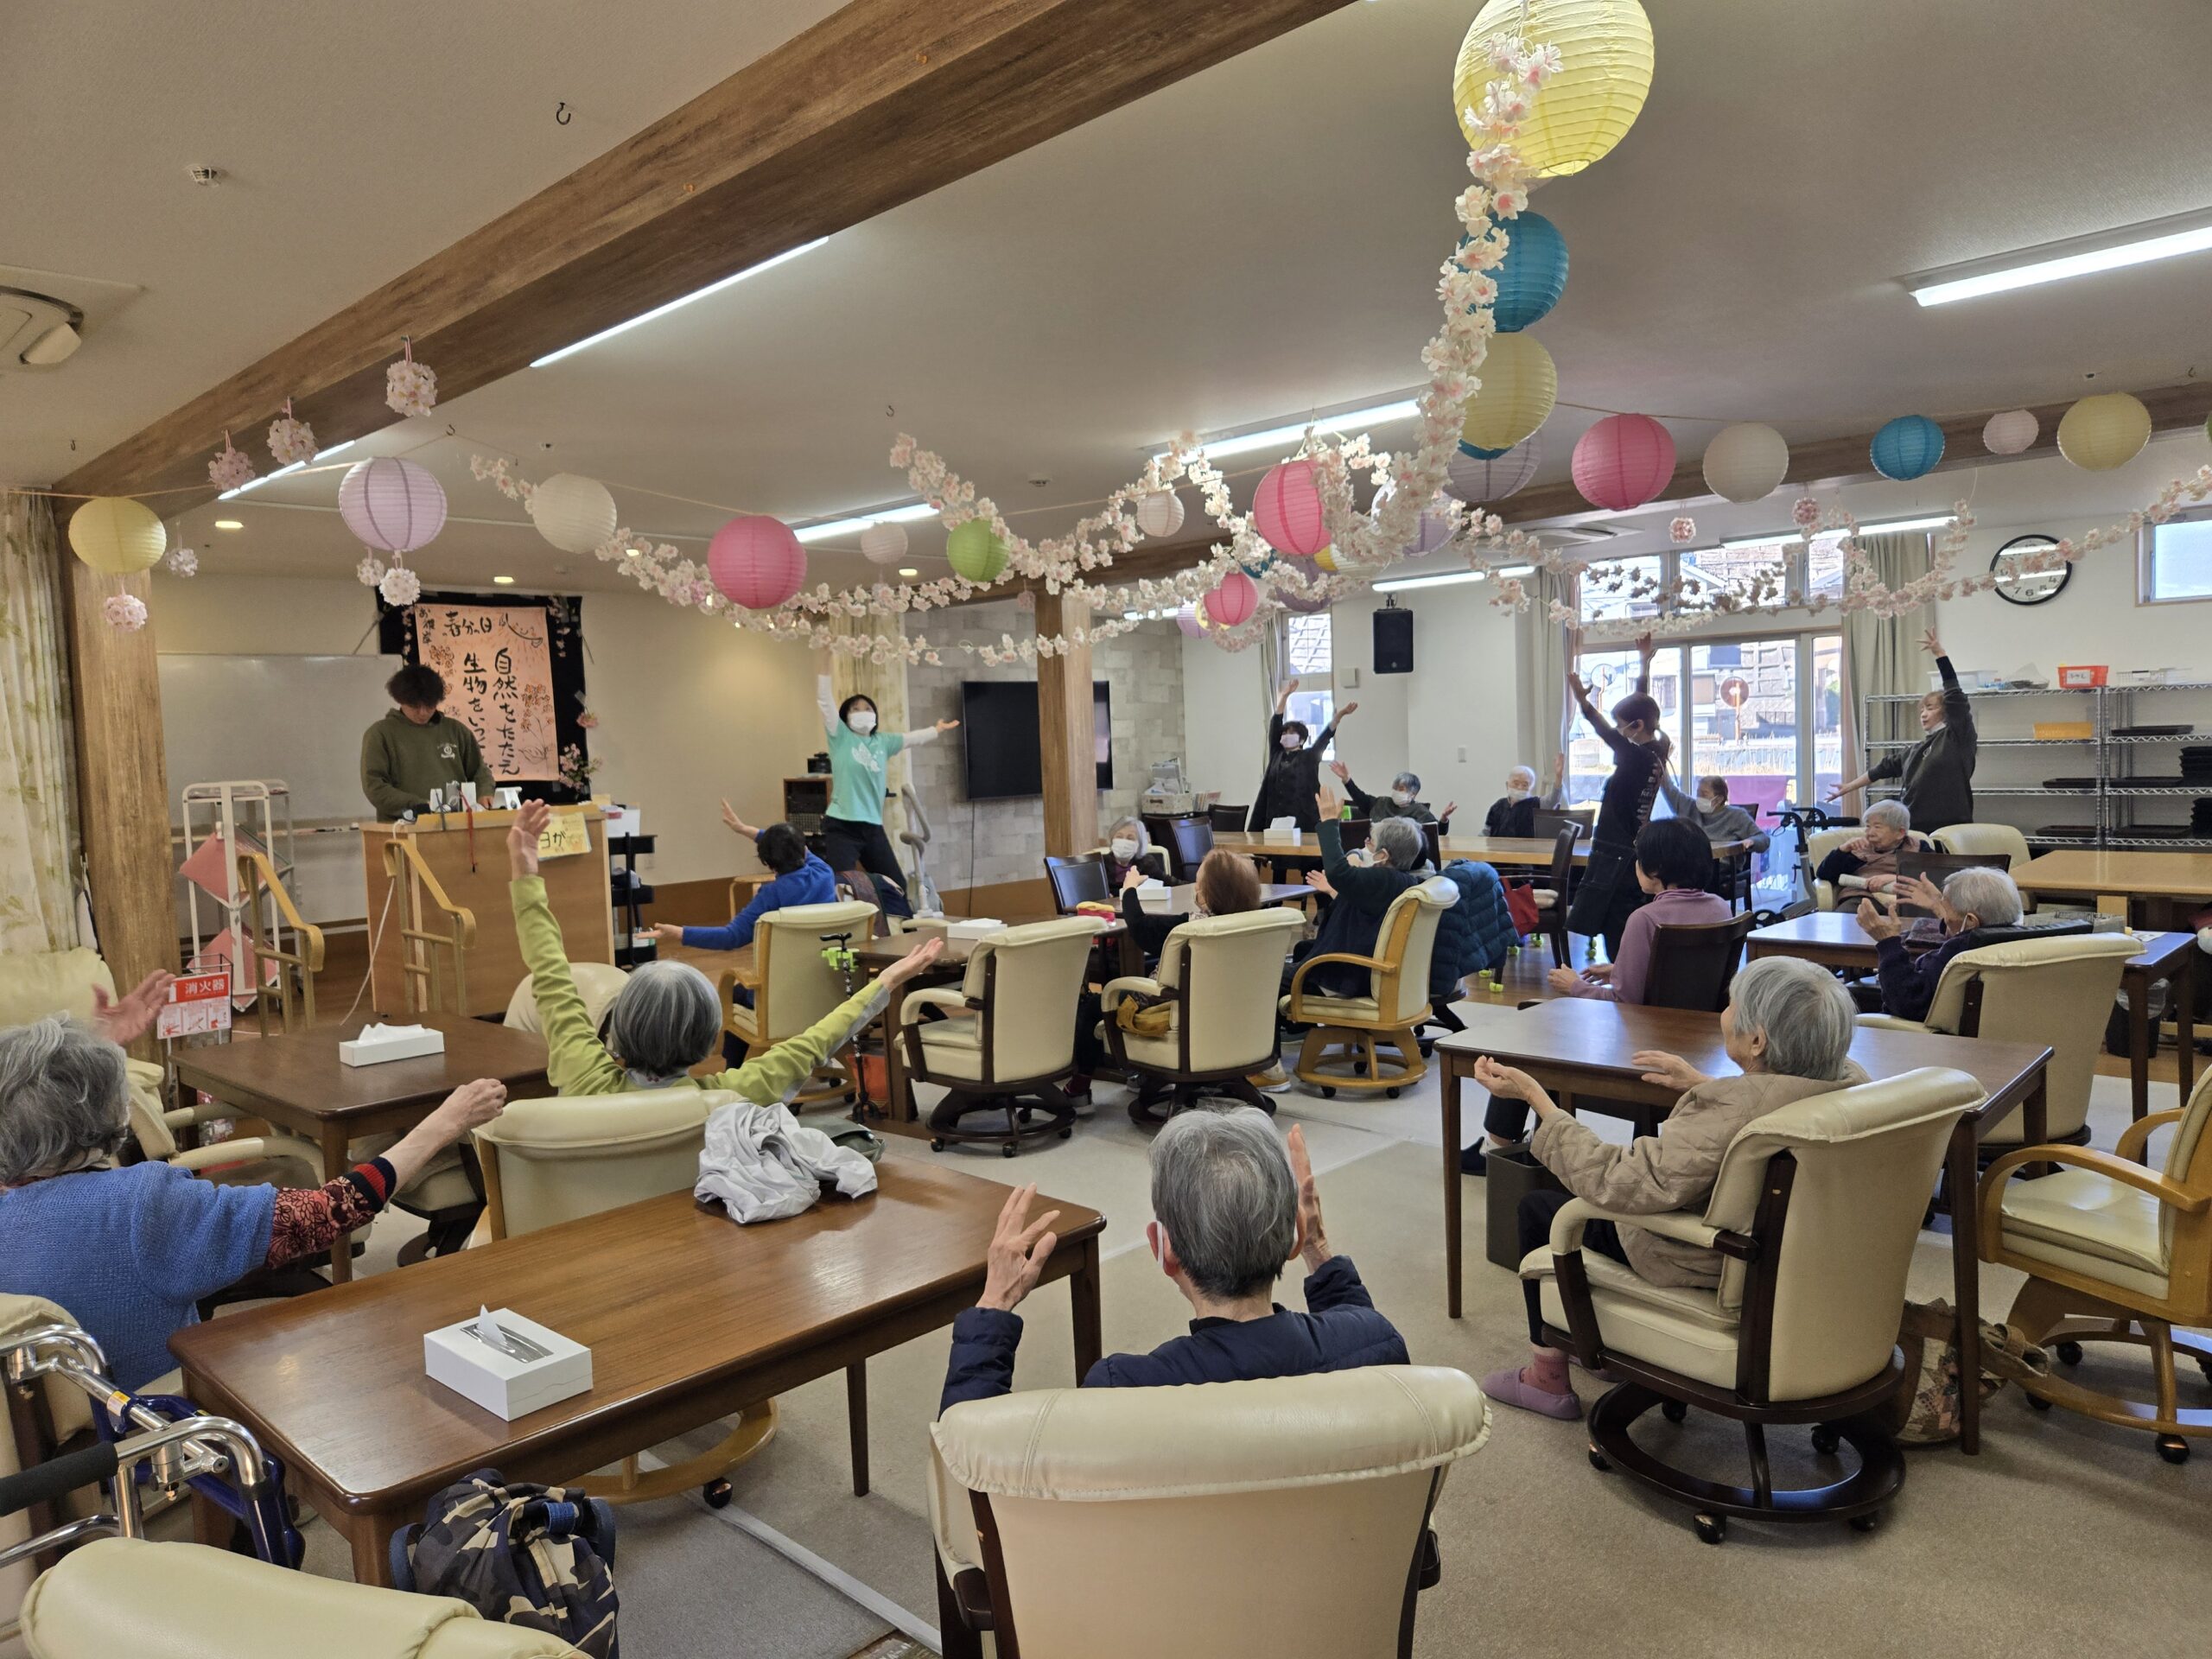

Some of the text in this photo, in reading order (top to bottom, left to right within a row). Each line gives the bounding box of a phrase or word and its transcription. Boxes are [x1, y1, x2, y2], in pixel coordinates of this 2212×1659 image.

[493, 647, 520, 775] 自然をたたえ
[184, 978, 226, 995] 消火器
